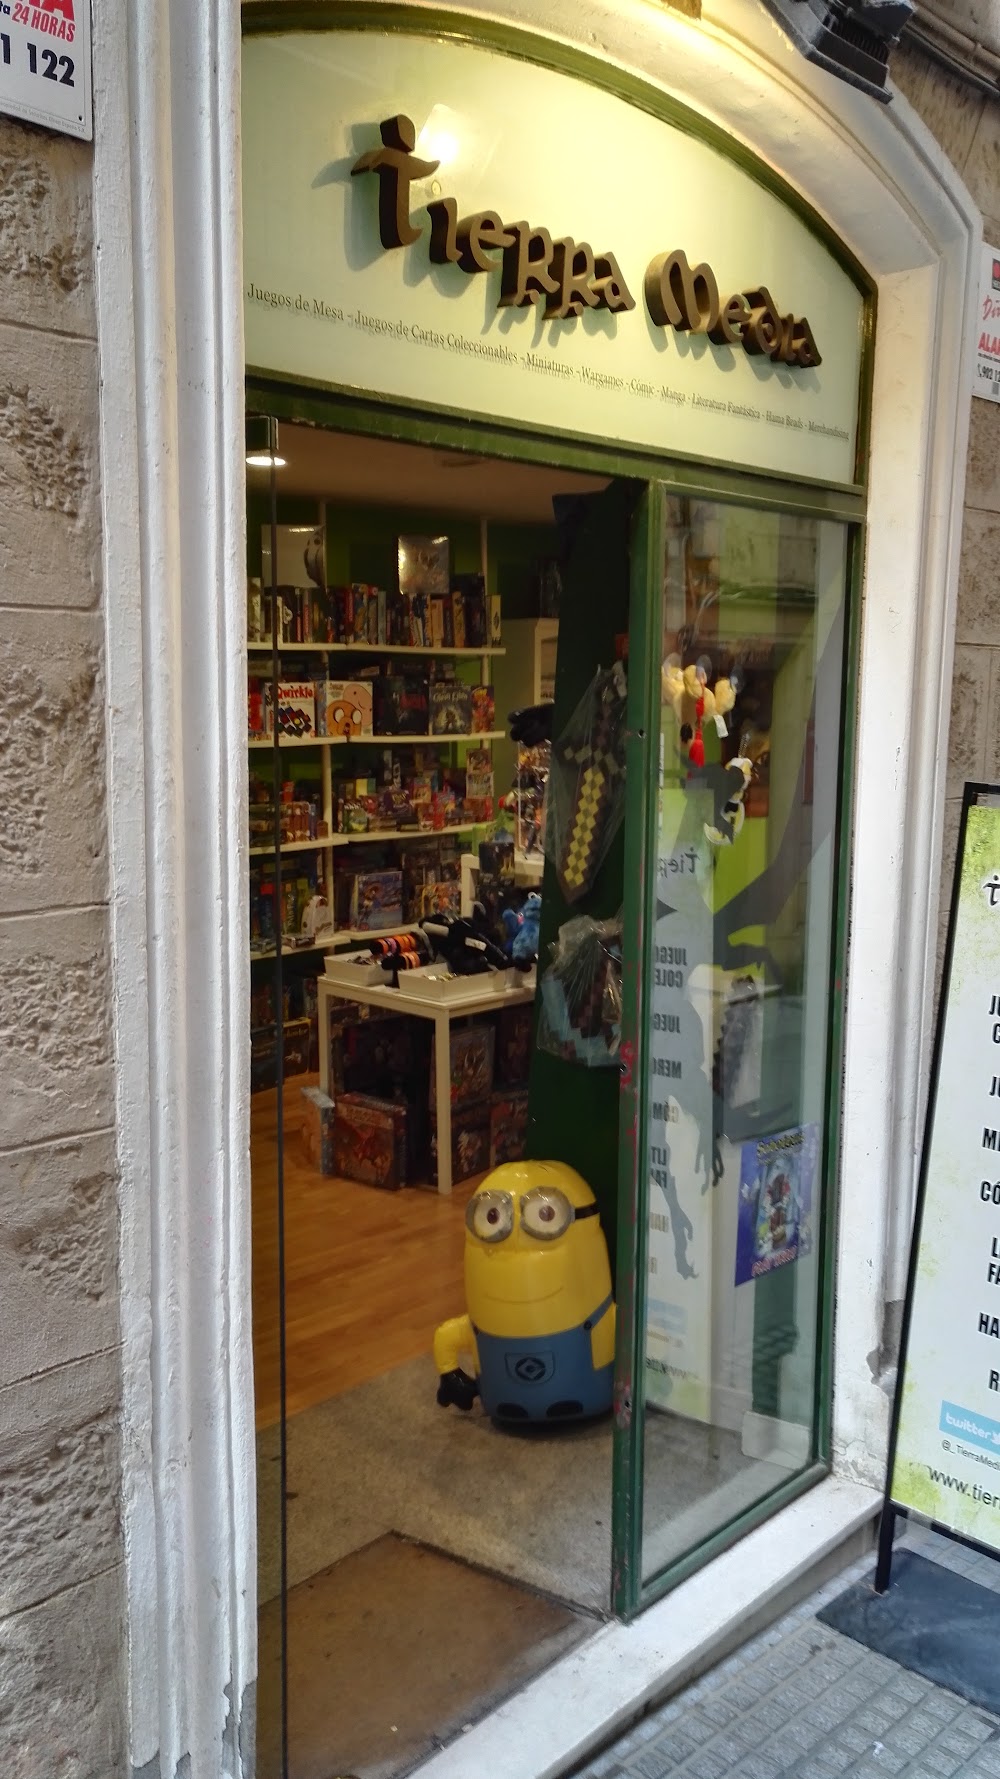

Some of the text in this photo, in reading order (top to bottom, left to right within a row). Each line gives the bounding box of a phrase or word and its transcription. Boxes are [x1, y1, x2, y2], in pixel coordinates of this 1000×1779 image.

[12, 2, 30, 25] 24
[31, 9, 76, 42] HORAS
[0, 32, 75, 88] 1 122
[247, 283, 291, 308] Juegos
[294, 294, 310, 312] de
[313, 298, 344, 321] Mesa
[354, 310, 393, 333] Juegos
[396, 320, 409, 336] de
[411, 324, 445, 345] Cartas
[447, 333, 518, 361] Coleccionables
[526, 352, 574, 376] Miniaturas
[581, 366, 624, 388] Wargames
[660, 385, 686, 402] Manga
[692, 392, 727, 411] Literatura
[766, 410, 785, 425] Hama
[785, 414, 804, 429] Beads
[978, 1311, 1000, 1339] HA
[945, 1411, 991, 1439] twitter
